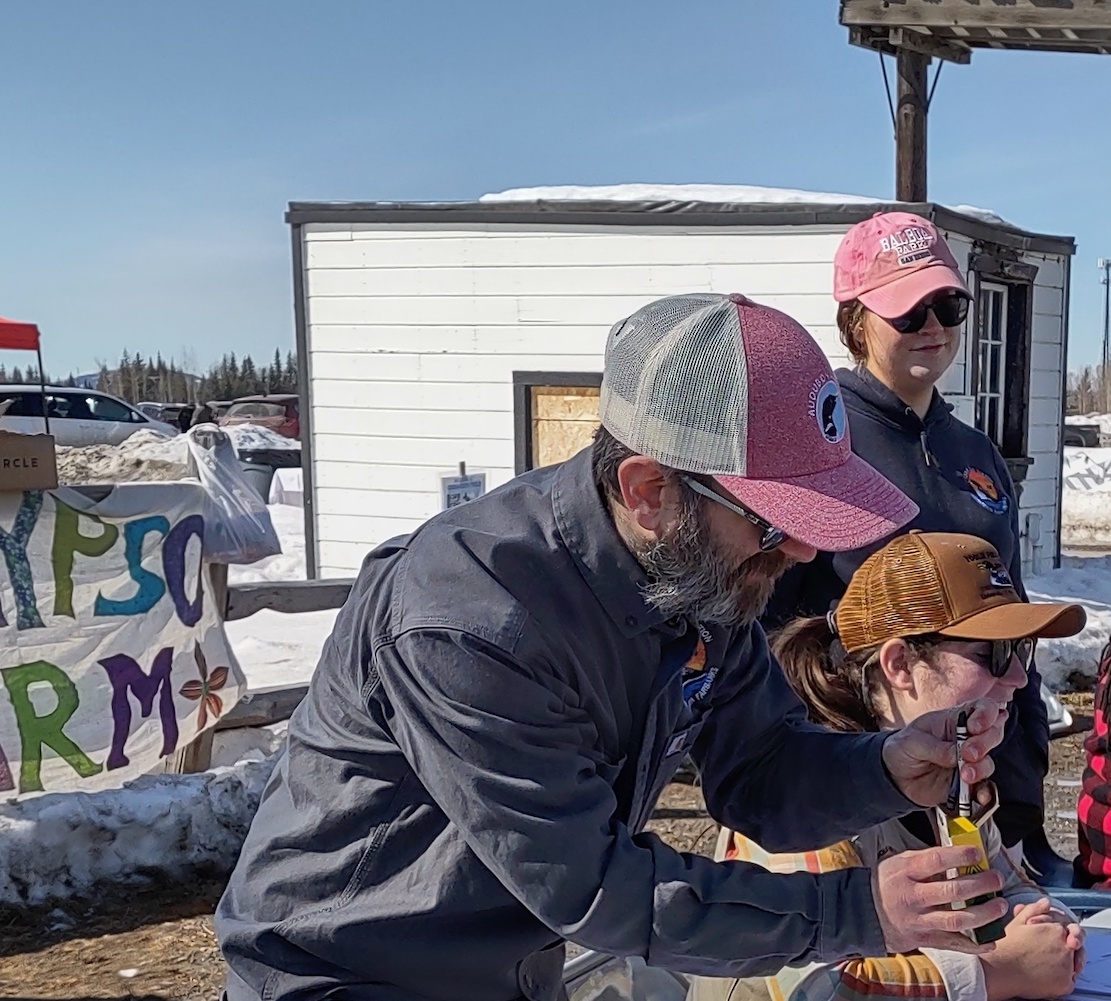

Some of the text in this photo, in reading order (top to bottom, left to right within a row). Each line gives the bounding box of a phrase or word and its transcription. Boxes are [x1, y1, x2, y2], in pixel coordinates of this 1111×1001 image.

[880, 227, 933, 253] BALBOA
[0, 491, 205, 630] YPSO
[0, 646, 181, 795] RM
